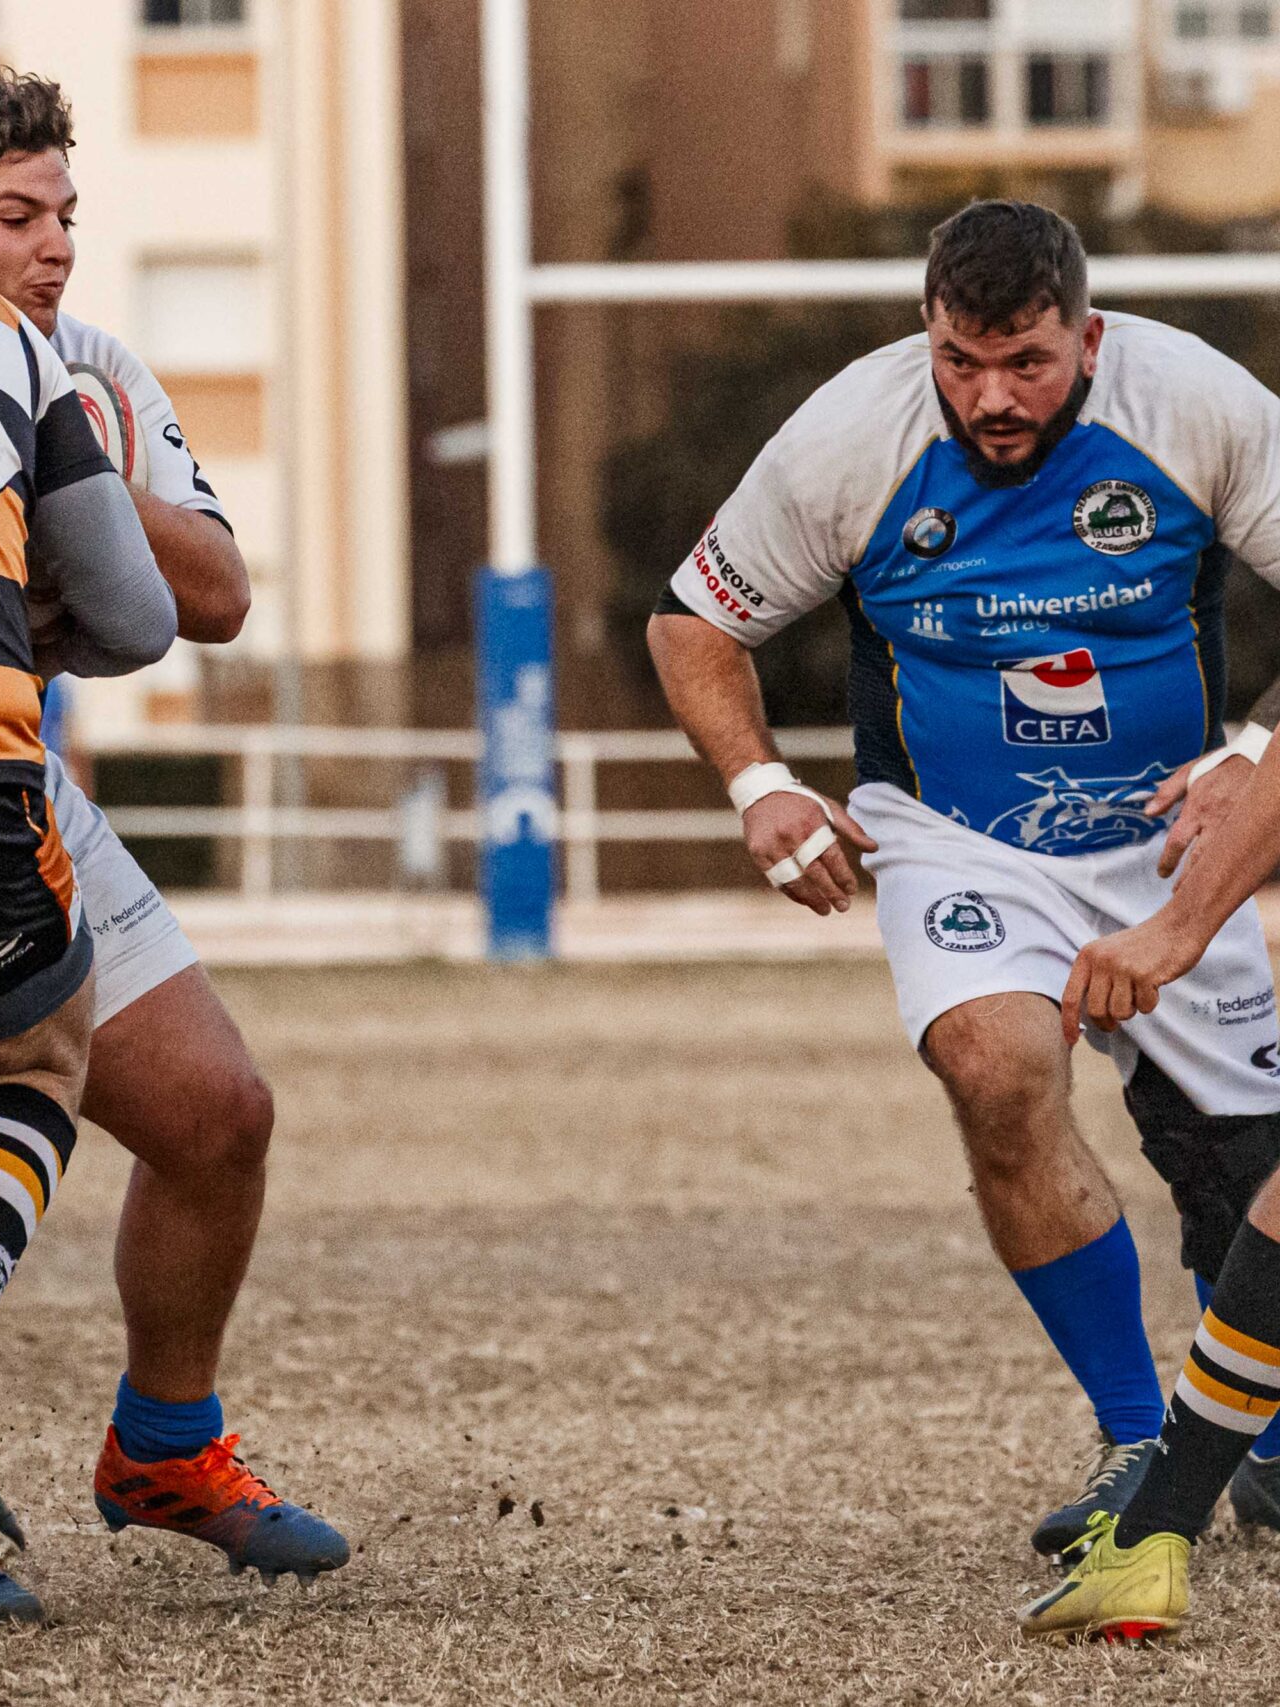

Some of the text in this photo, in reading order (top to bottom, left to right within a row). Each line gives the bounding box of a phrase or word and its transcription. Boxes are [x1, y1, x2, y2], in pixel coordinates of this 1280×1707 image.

[693, 540, 752, 622] DEPORTE
[976, 578, 1153, 618] Universidad
[1015, 718, 1100, 742] CEFA
